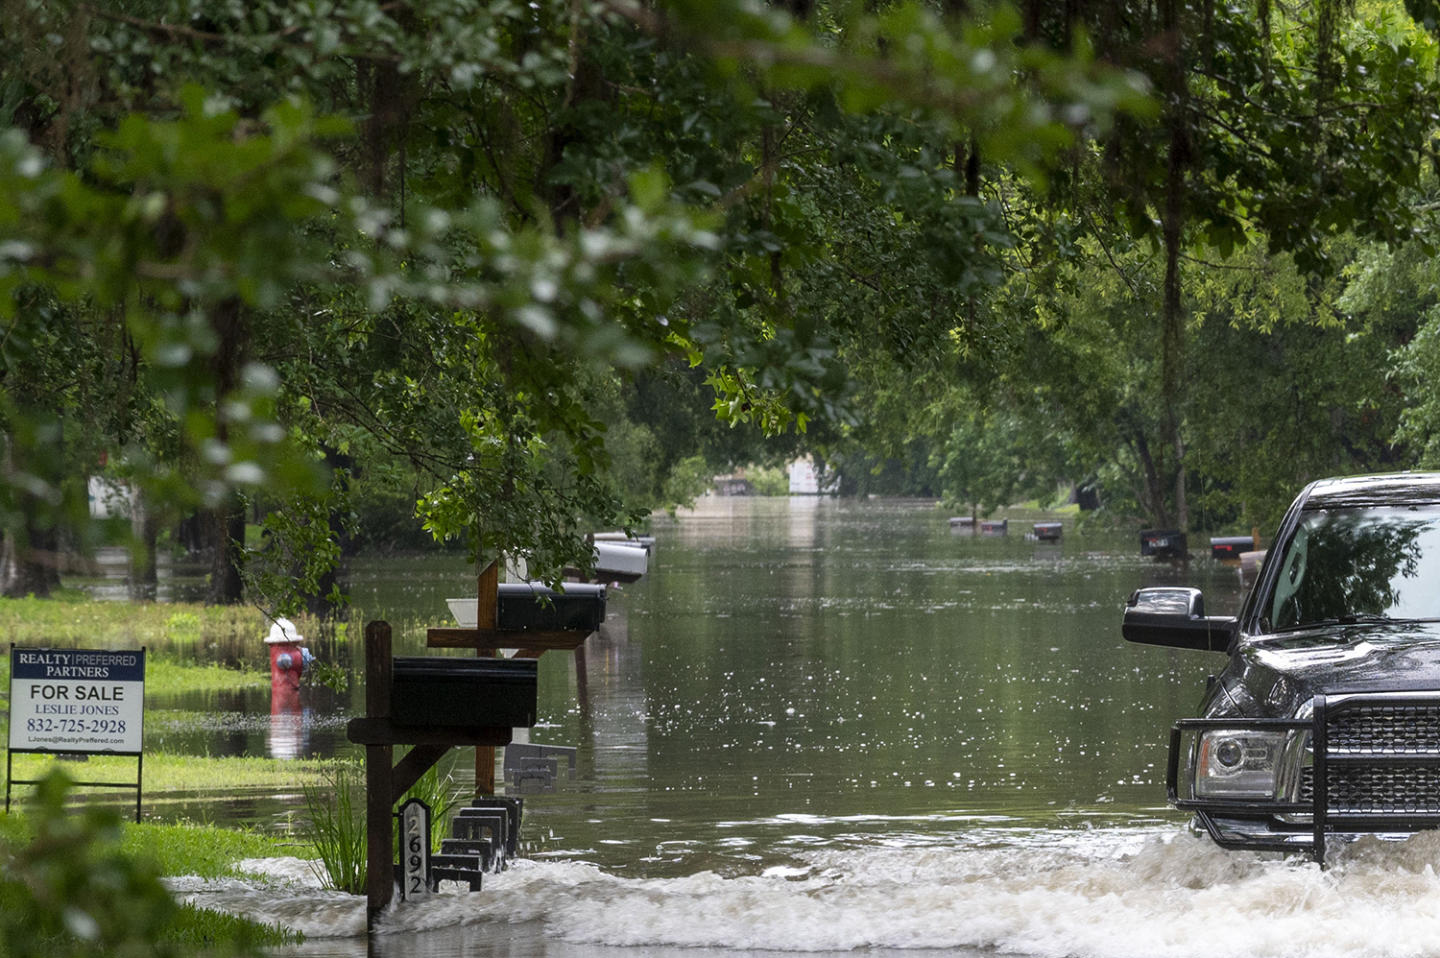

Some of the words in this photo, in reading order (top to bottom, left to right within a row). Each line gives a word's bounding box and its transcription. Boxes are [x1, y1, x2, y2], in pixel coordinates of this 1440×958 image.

[19, 653, 71, 665] REALTY
[75, 654, 137, 666] PREFERRED
[46, 666, 110, 678] PARTNERS
[30, 684, 69, 700] FOR
[74, 685, 124, 701] SALE
[35, 703, 77, 715] LESLIE
[79, 704, 119, 716] JONES
[27, 718, 126, 734] 832-725-2928
[408, 815, 423, 894] 2692
